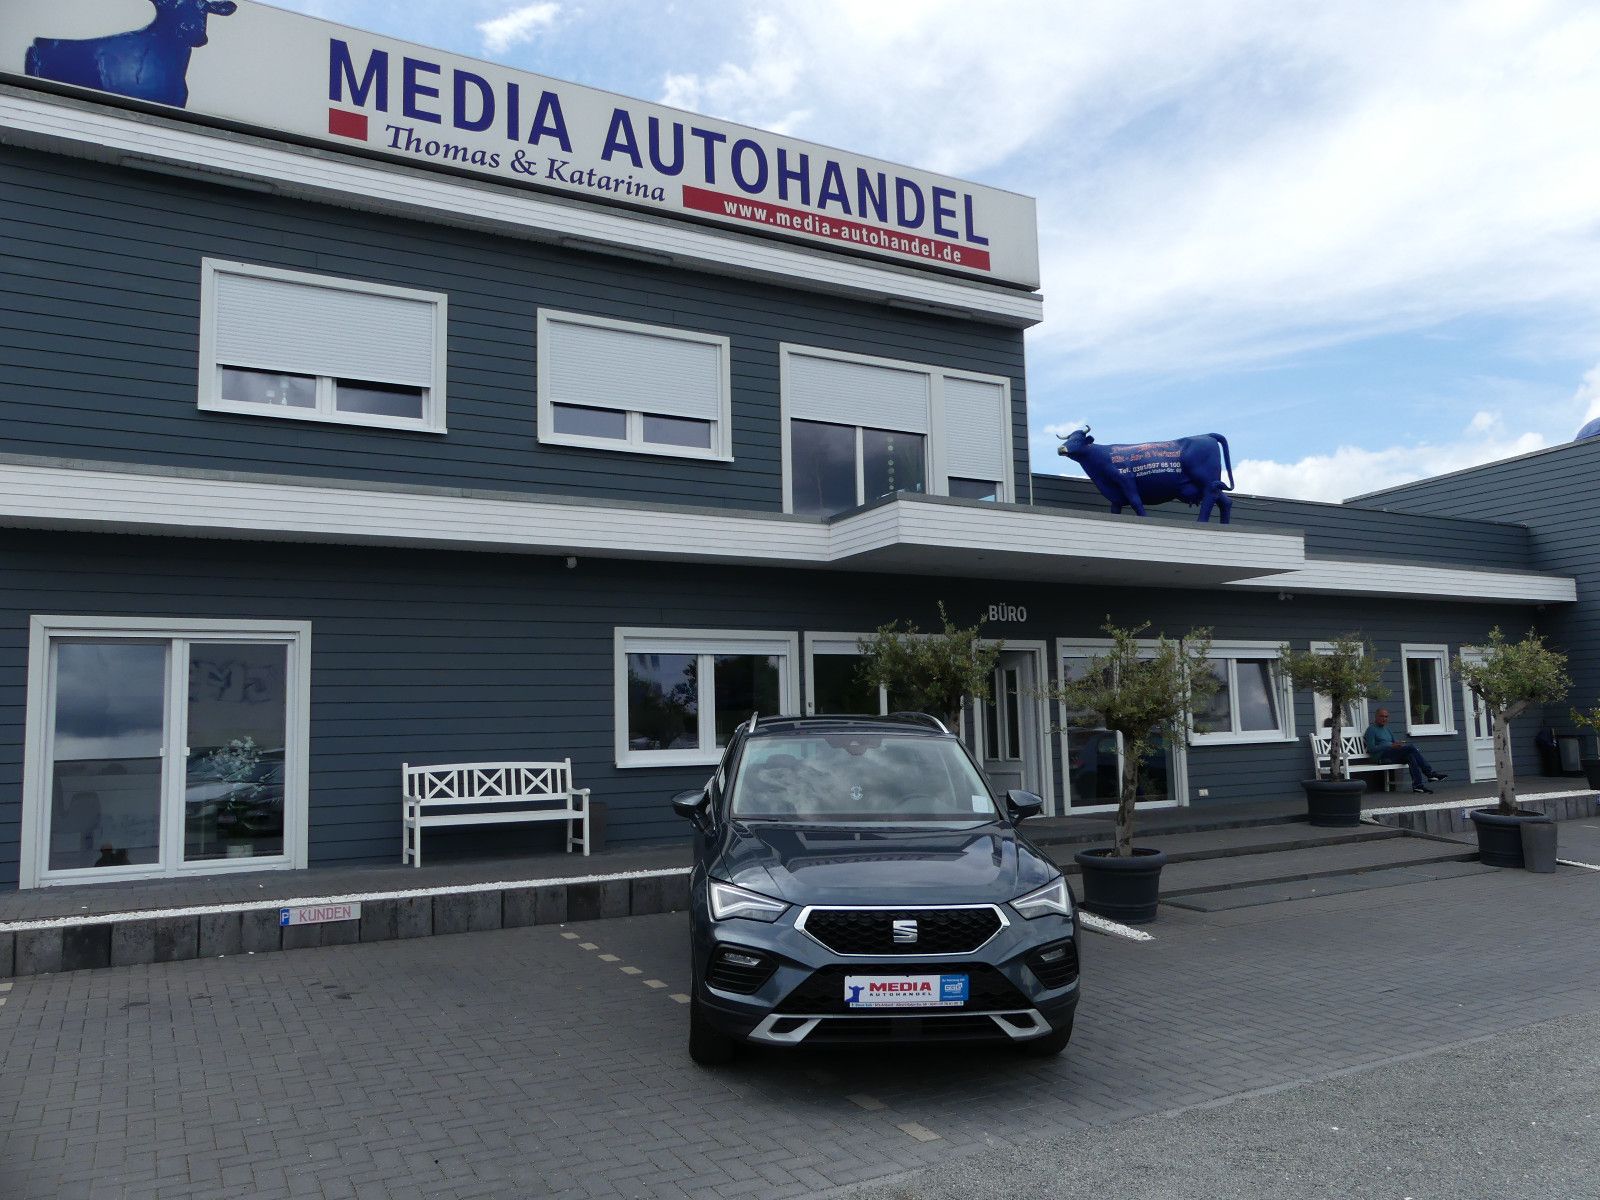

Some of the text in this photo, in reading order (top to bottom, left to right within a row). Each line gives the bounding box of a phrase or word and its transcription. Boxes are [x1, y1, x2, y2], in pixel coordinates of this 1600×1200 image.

[328, 38, 989, 246] MEDIA AUTOHANDEL
[385, 124, 666, 202] Thomas & Katarina
[723, 200, 961, 263] www.media-autohandel.de
[988, 602, 1027, 623] BÜRO
[281, 905, 352, 923] P KUNDEN
[869, 982, 932, 992] MEDIA
